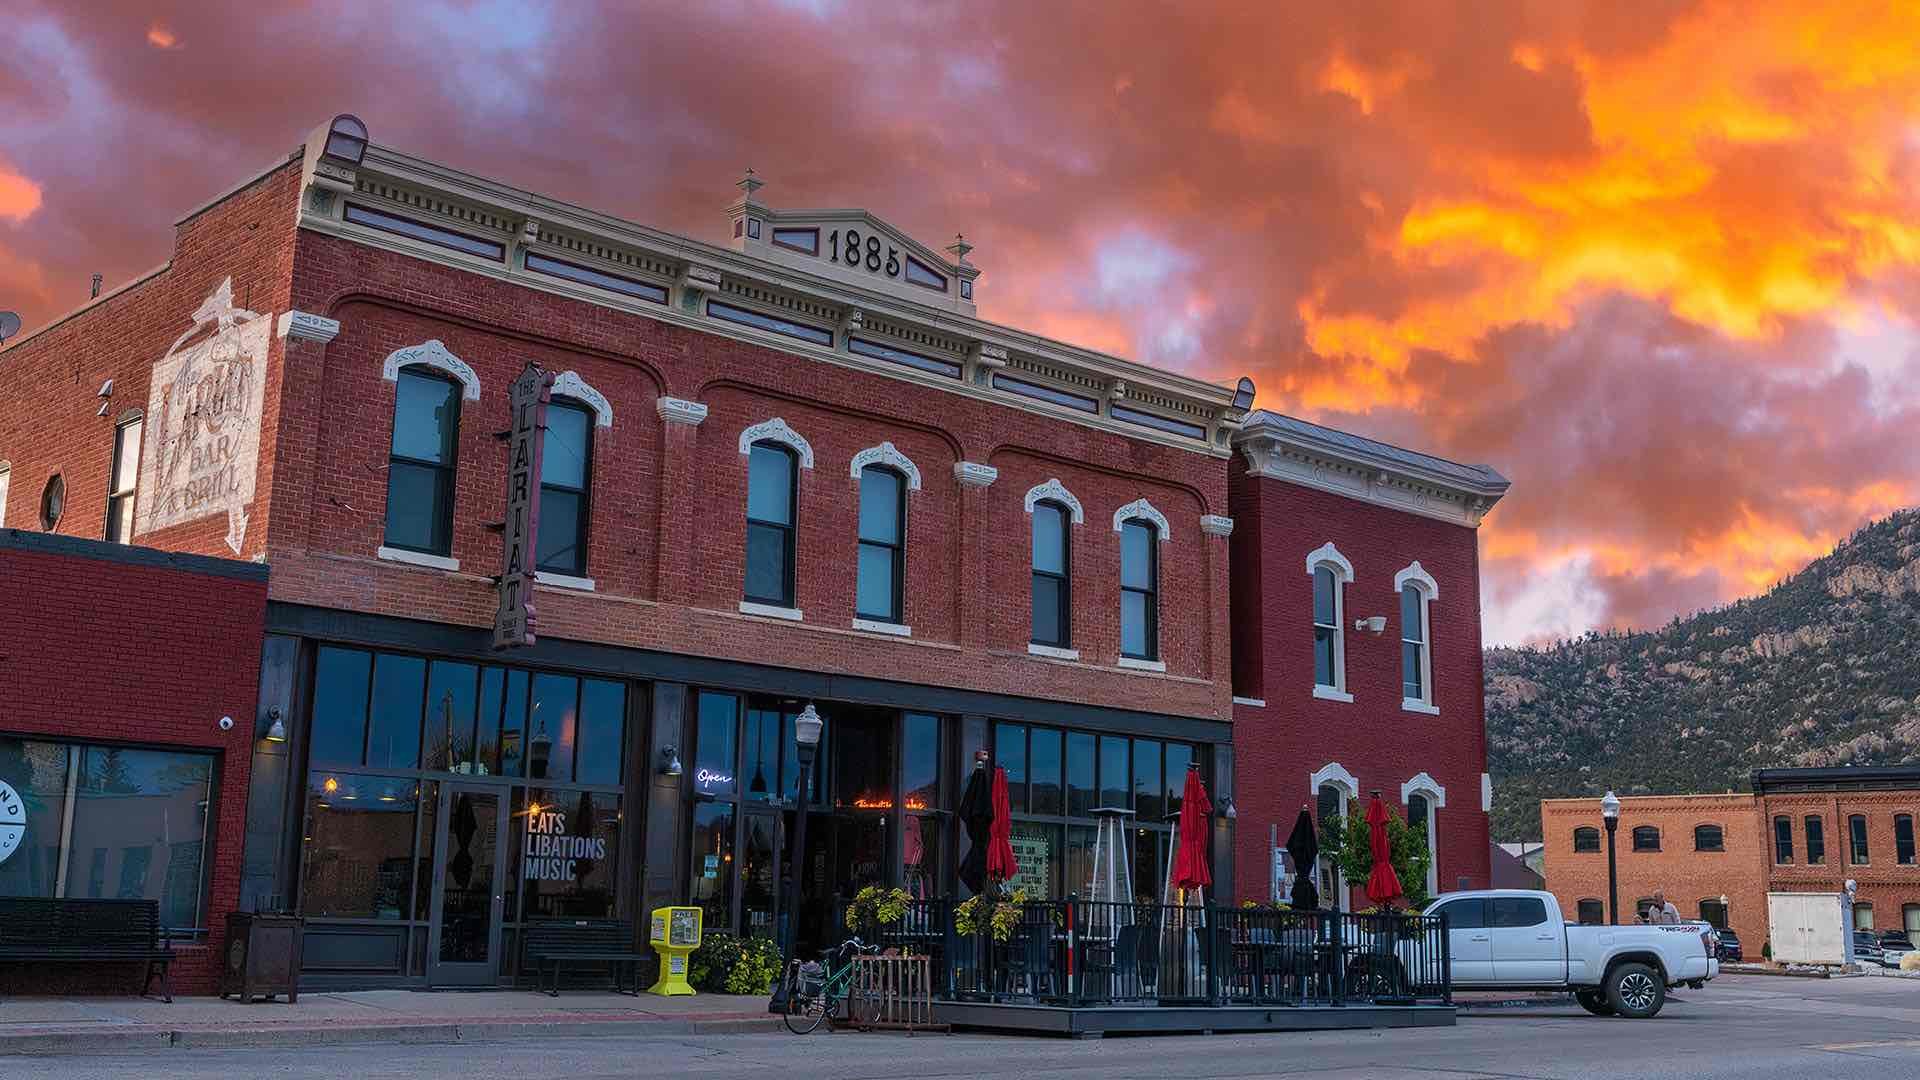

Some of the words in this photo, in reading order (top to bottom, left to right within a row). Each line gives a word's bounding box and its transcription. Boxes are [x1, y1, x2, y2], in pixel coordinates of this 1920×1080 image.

[829, 229, 900, 277] 1885
[518, 379, 537, 398] THE
[189, 434, 233, 473] BAR
[507, 402, 531, 612] LARIAT
[697, 768, 733, 788] Open
[528, 812, 566, 834] EATS
[526, 834, 606, 860] LIBATIONS
[525, 857, 577, 881] MUSIC
